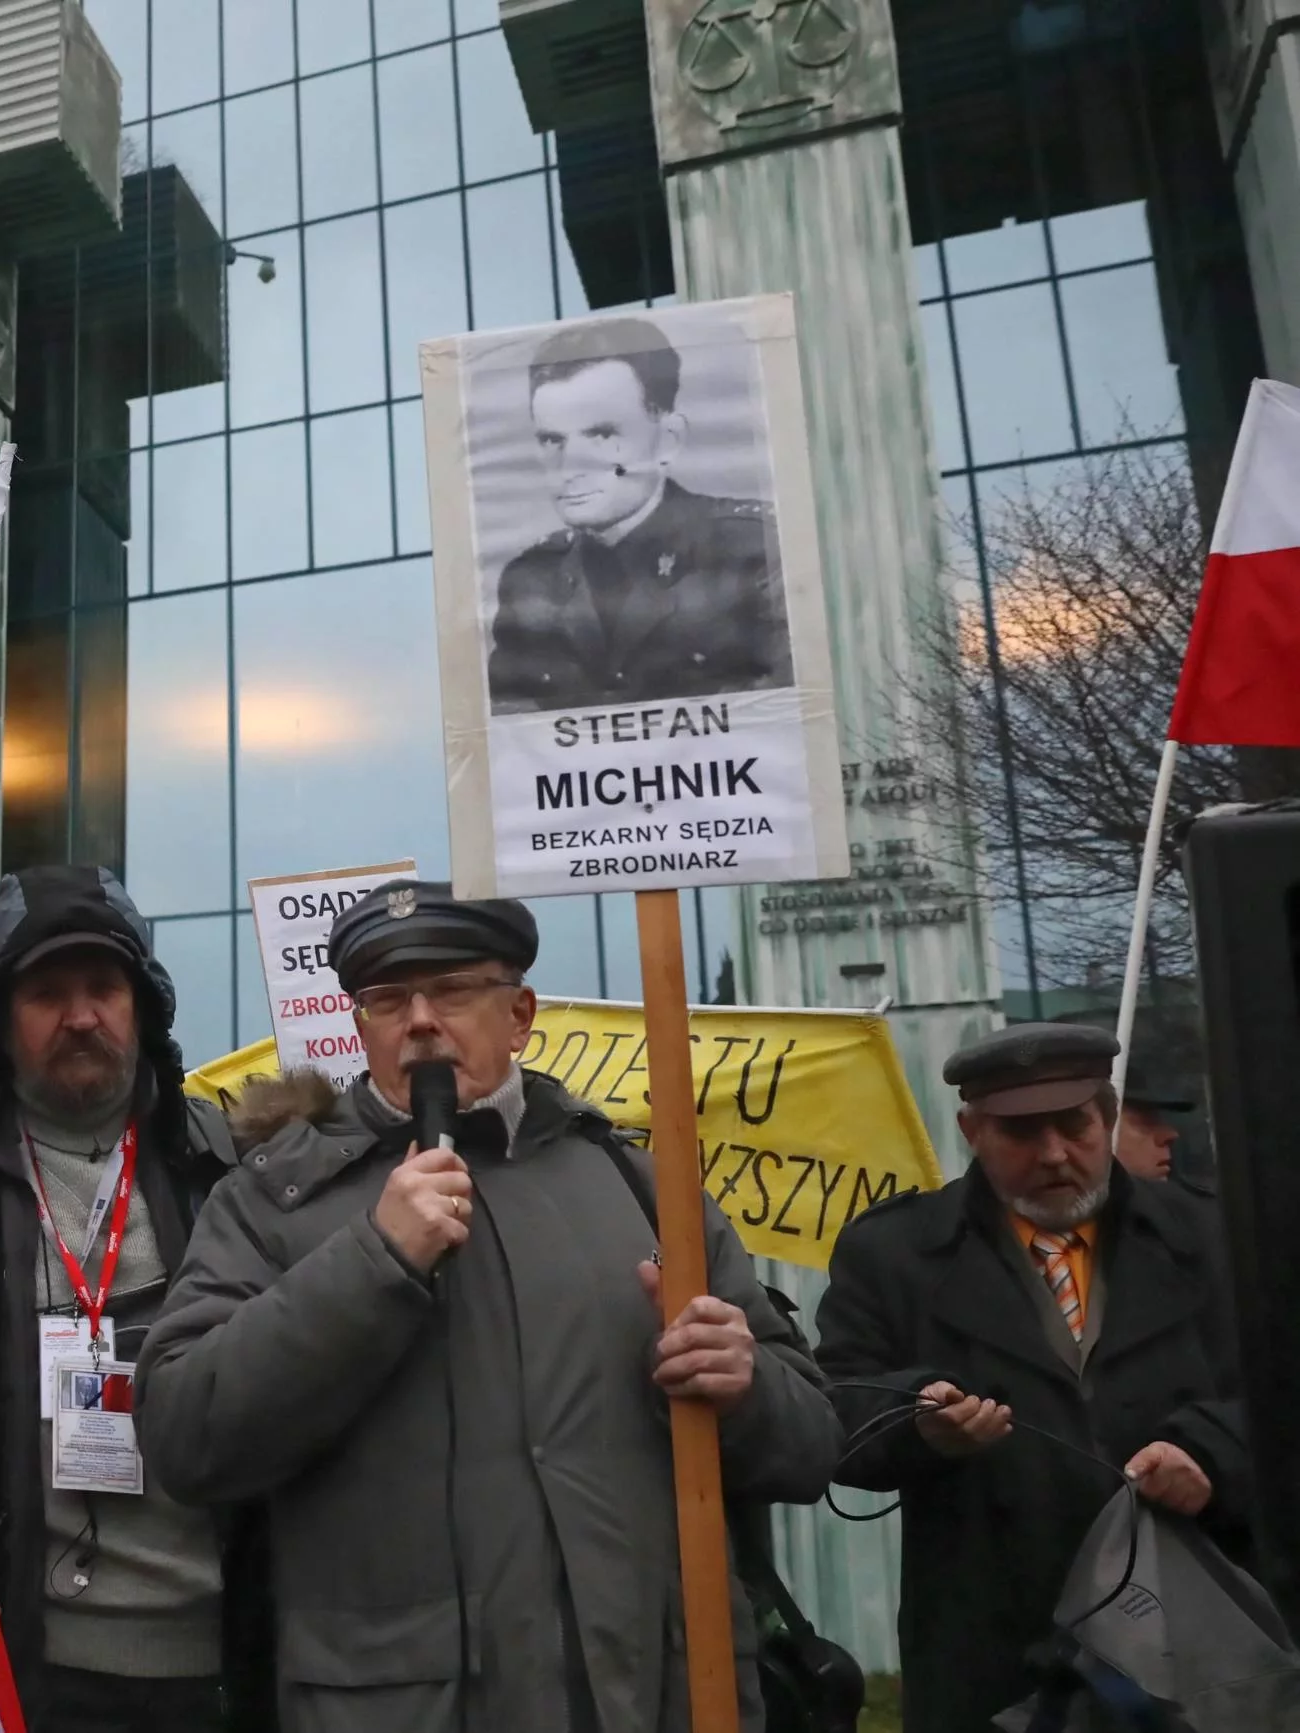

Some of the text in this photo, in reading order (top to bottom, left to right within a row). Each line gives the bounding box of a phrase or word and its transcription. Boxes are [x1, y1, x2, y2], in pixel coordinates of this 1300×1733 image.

[553, 703, 731, 748] STEFAN
[536, 757, 762, 811] MICHNIK
[532, 816, 774, 851] BEZKARNY SĘDZIA
[569, 850, 739, 878] ZBRODNIARZ
[278, 889, 371, 920] OSĄD
[281, 943, 331, 975] SĘD
[279, 993, 355, 1019] ZBROD
